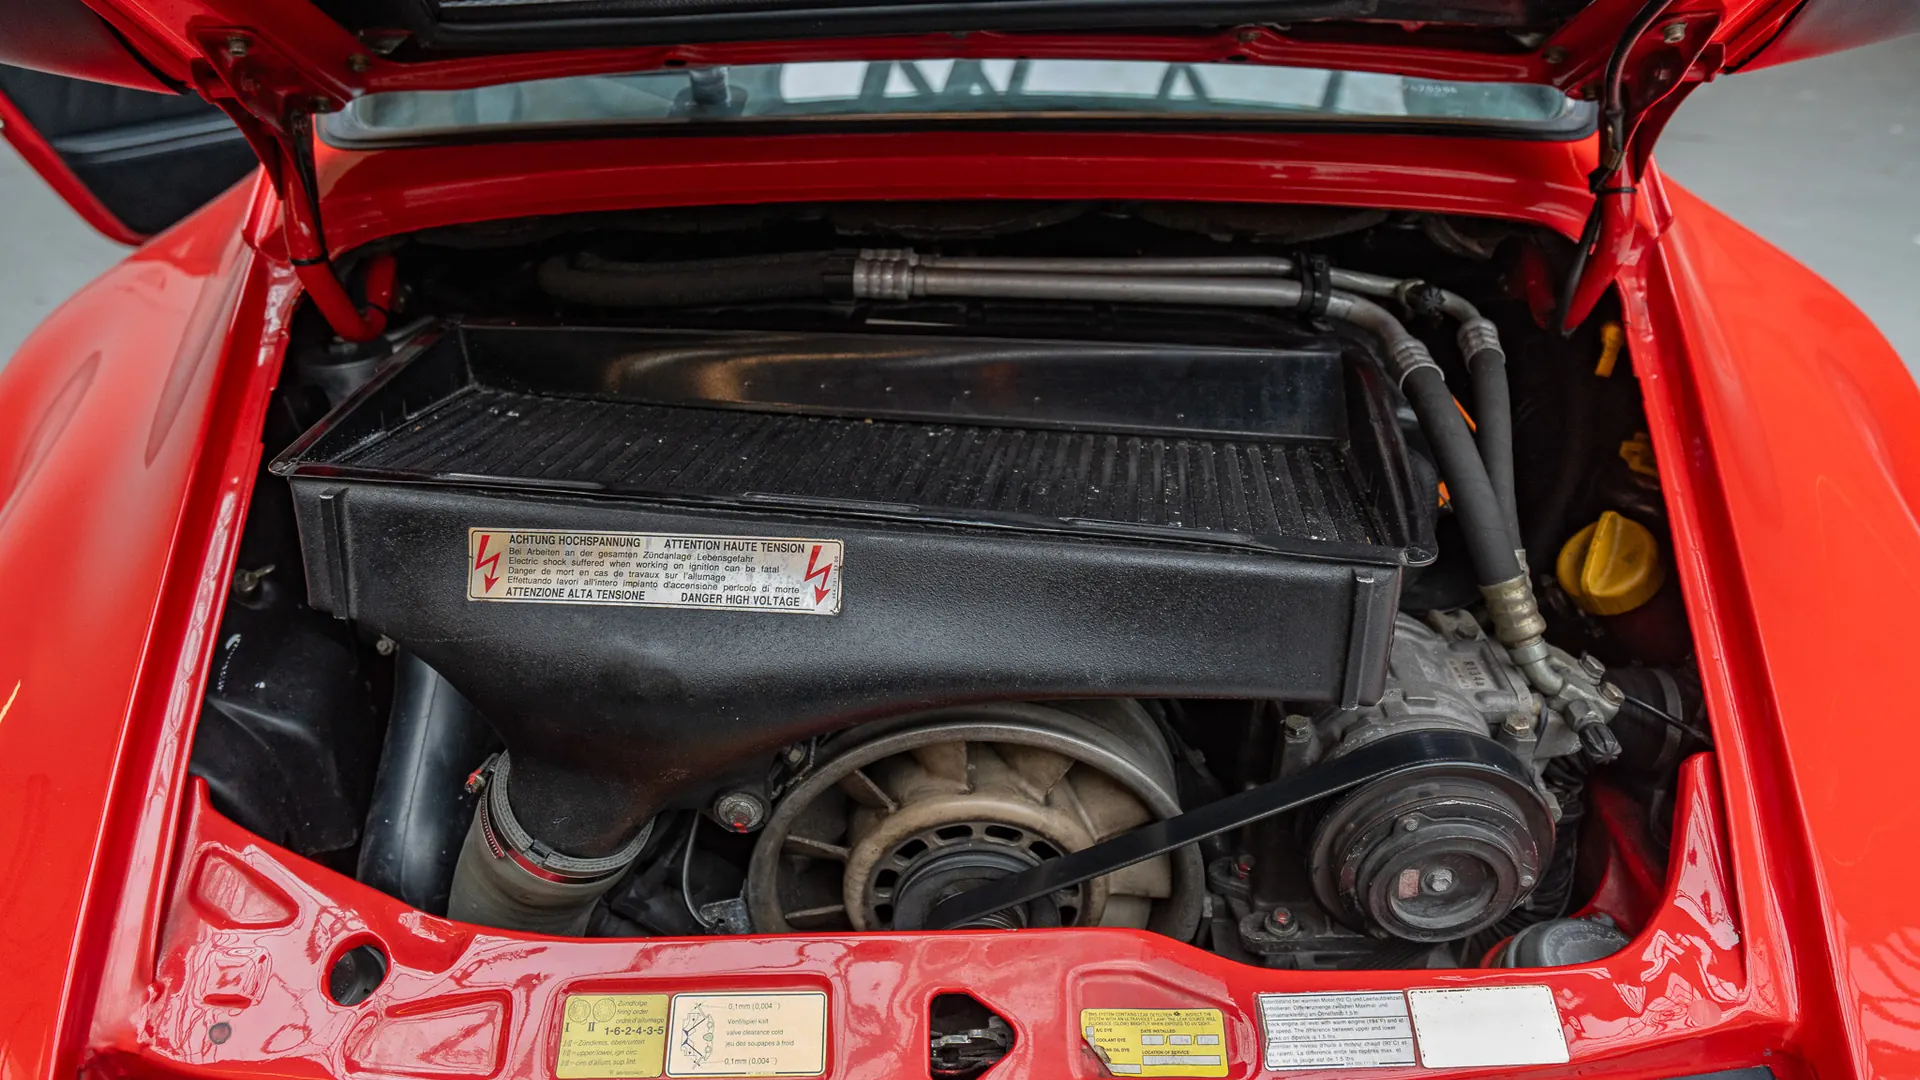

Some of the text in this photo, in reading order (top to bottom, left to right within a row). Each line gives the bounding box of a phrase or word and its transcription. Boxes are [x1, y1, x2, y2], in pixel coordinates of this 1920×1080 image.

[509, 534, 640, 548] ACHTUNG HOCHSPANNUNG
[664, 539, 805, 554] ATTENTION HAUTE TENSION
[527, 548, 560, 556] Arbeiten
[580, 550, 593, 558] der
[598, 550, 638, 560] gesamten
[643, 550, 692, 562] Zündanlage
[697, 554, 754, 563] Lebensgefahr
[509, 558, 538, 566] Electric
[572, 558, 604, 567] suffered
[610, 560, 630, 568] when
[636, 560, 668, 570] working
[689, 562, 715, 572] ignition
[746, 564, 756, 572] be
[761, 565, 780, 574] fatal
[508, 566, 536, 576] Danger
[541, 568, 551, 576] de
[613, 569, 624, 578] de
[628, 570, 660, 579] travaux
[683, 572, 726, 582] l'allumage
[508, 576, 552, 585] Effettuando
[556, 576, 580, 585] lavori
[584, 578, 618, 587] all'intero
[622, 580, 658, 590] impianto
[664, 581, 718, 590] d'accensione
[723, 583, 757, 594] pericolo
[762, 584, 770, 592] di
[506, 587, 646, 600] ATTENZIONE ALTA TENSIONE
[681, 592, 800, 606] DANGER HIGH VOLTAGE
[564, 1022, 596, 1032] I II
[604, 1026, 664, 1036] 1-6-2-4-3-5
